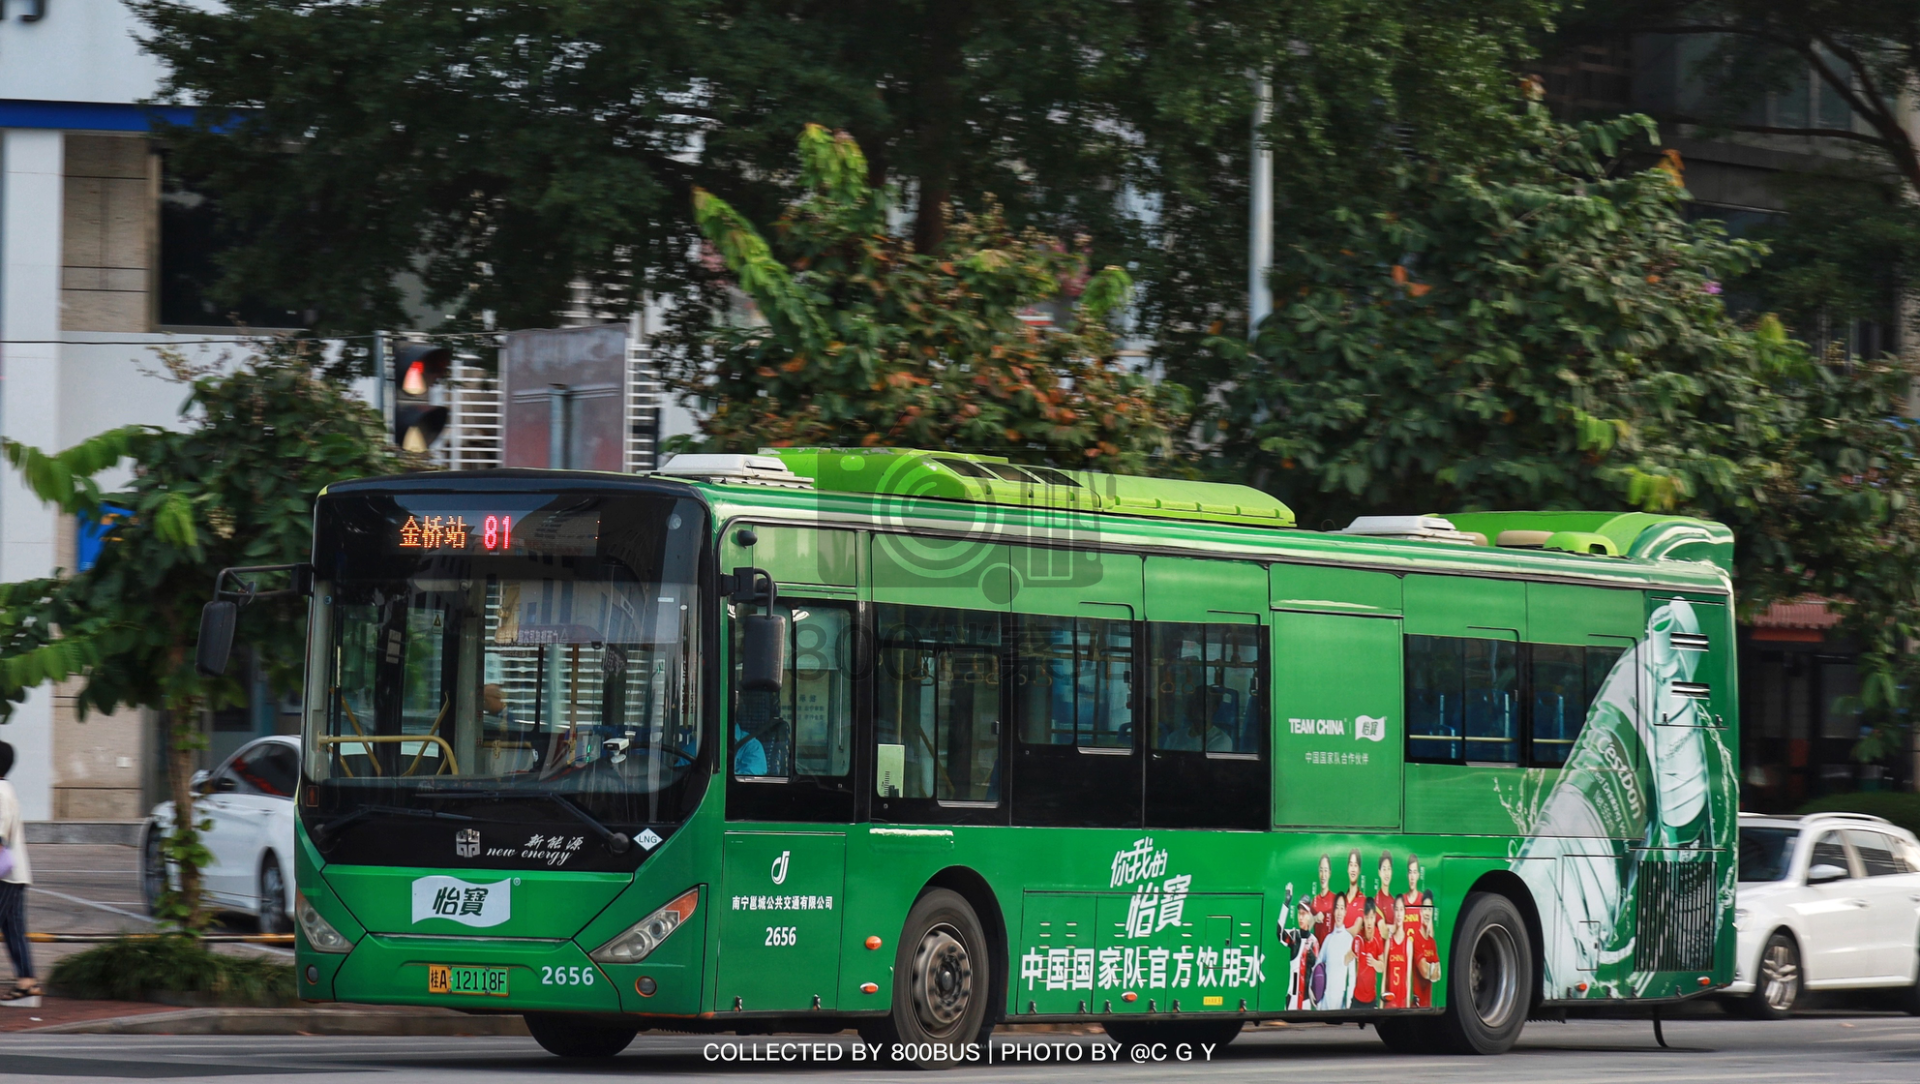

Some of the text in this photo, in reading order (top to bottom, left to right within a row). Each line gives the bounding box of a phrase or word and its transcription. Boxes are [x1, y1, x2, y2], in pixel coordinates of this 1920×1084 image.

[399, 514, 511, 549] 金桥站 81
[1288, 717, 1345, 735] TEAM CHINA
[1305, 751, 1369, 765] 中国国家队合作伙伴
[524, 834, 584, 850] 新能源
[638, 835, 658, 844] LNG
[486, 847, 574, 866] new energy
[1110, 836, 1168, 888] 你我的
[732, 895, 833, 911] 南宁邕城公共交通有限公司
[765, 926, 797, 947] 2656
[541, 966, 595, 986] 2656
[1021, 945, 1266, 991] 中国国家队官方饮用水
[1393, 966, 1401, 986] 5
